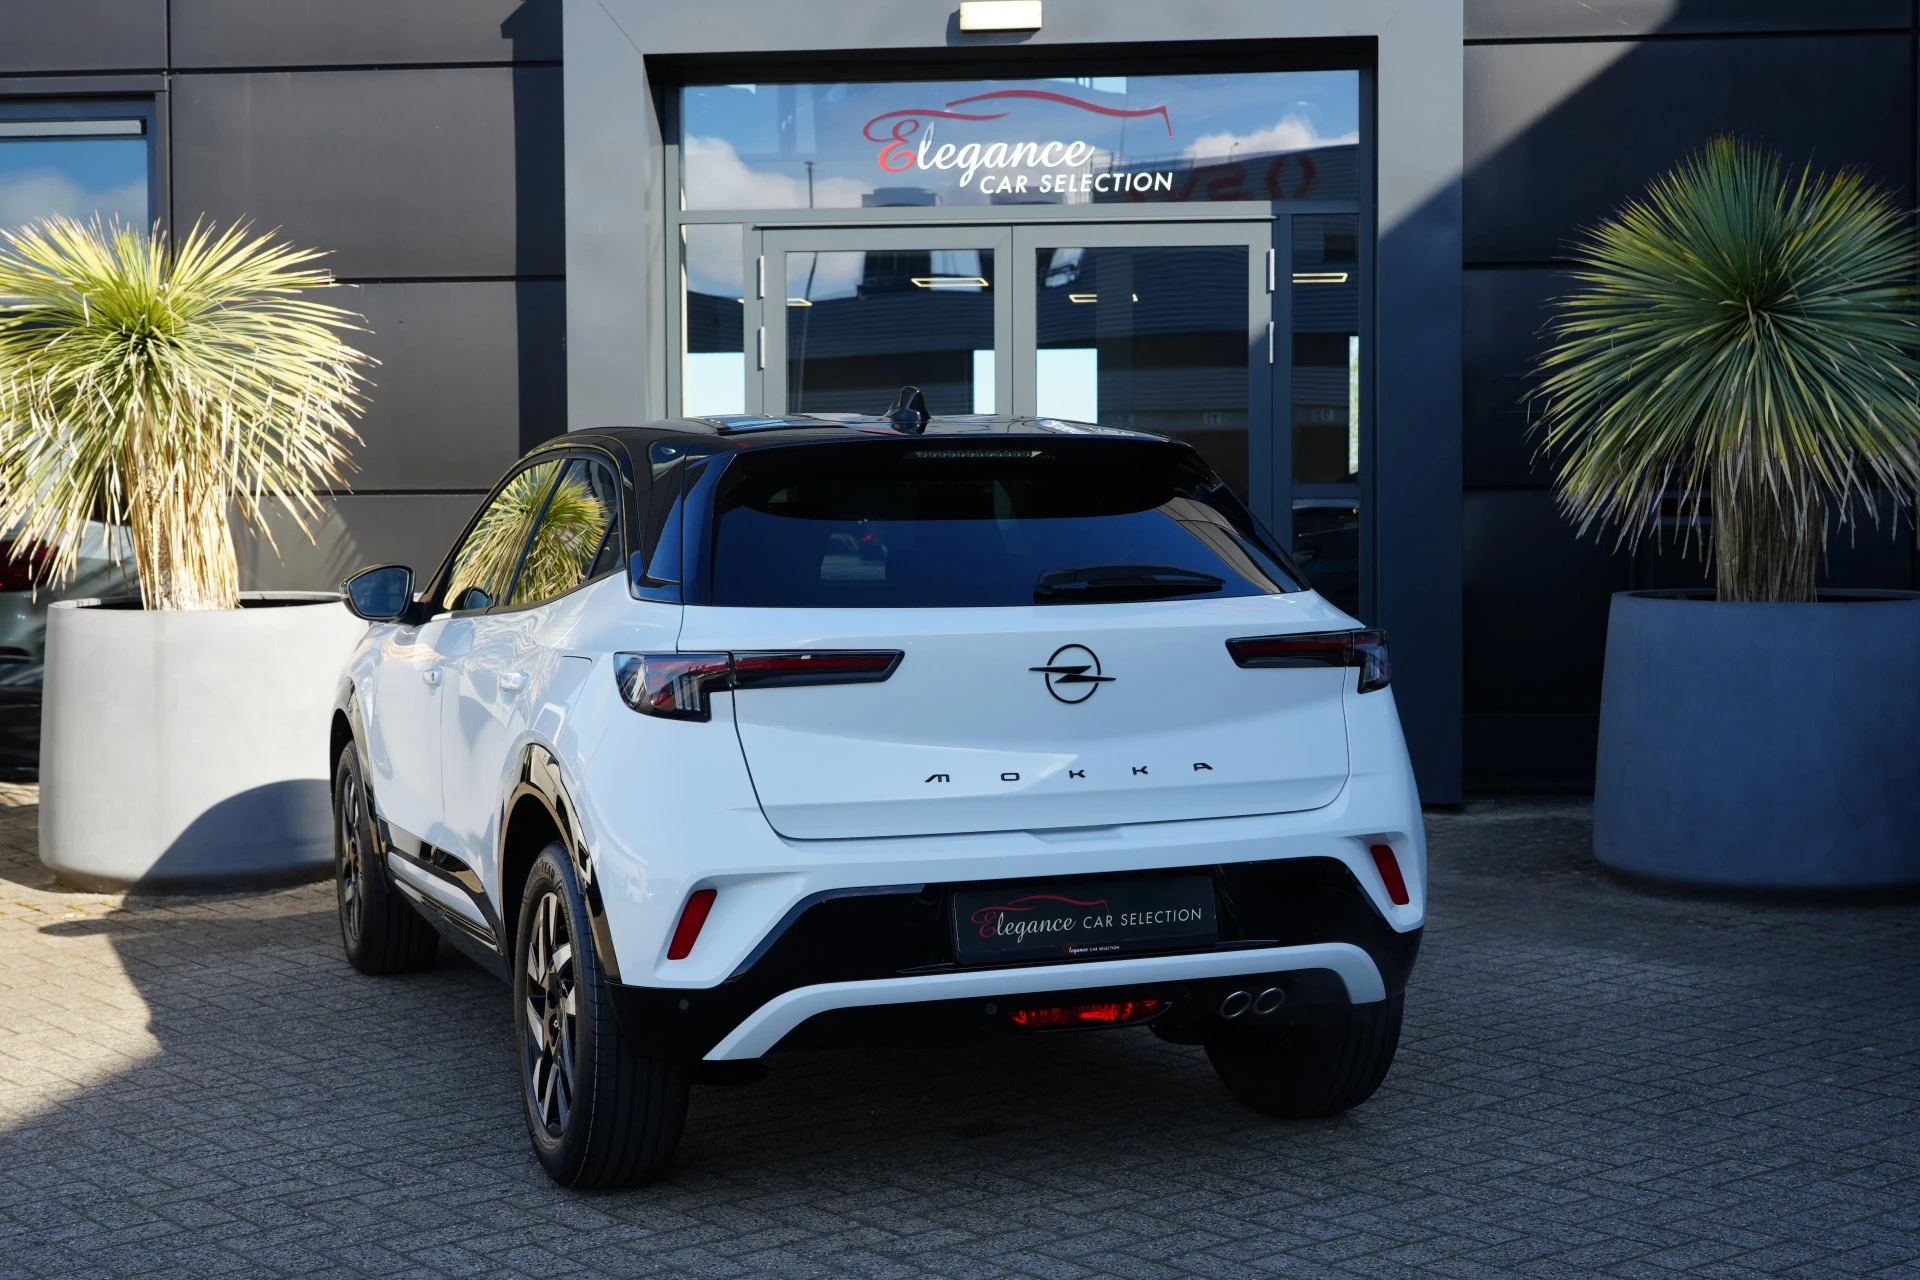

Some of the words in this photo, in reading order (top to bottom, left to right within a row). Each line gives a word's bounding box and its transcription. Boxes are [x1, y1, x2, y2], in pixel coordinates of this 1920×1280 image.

[864, 112, 1095, 188] Elegance
[980, 175, 1028, 194] CAR
[1039, 172, 1173, 193] SELECTION
[925, 762, 1213, 783] MOKKA
[971, 909, 1076, 943] Elegance
[1083, 915, 1113, 929] CAR
[1120, 908, 1202, 926] SELECTION
[1063, 945, 1088, 955] Elegance
